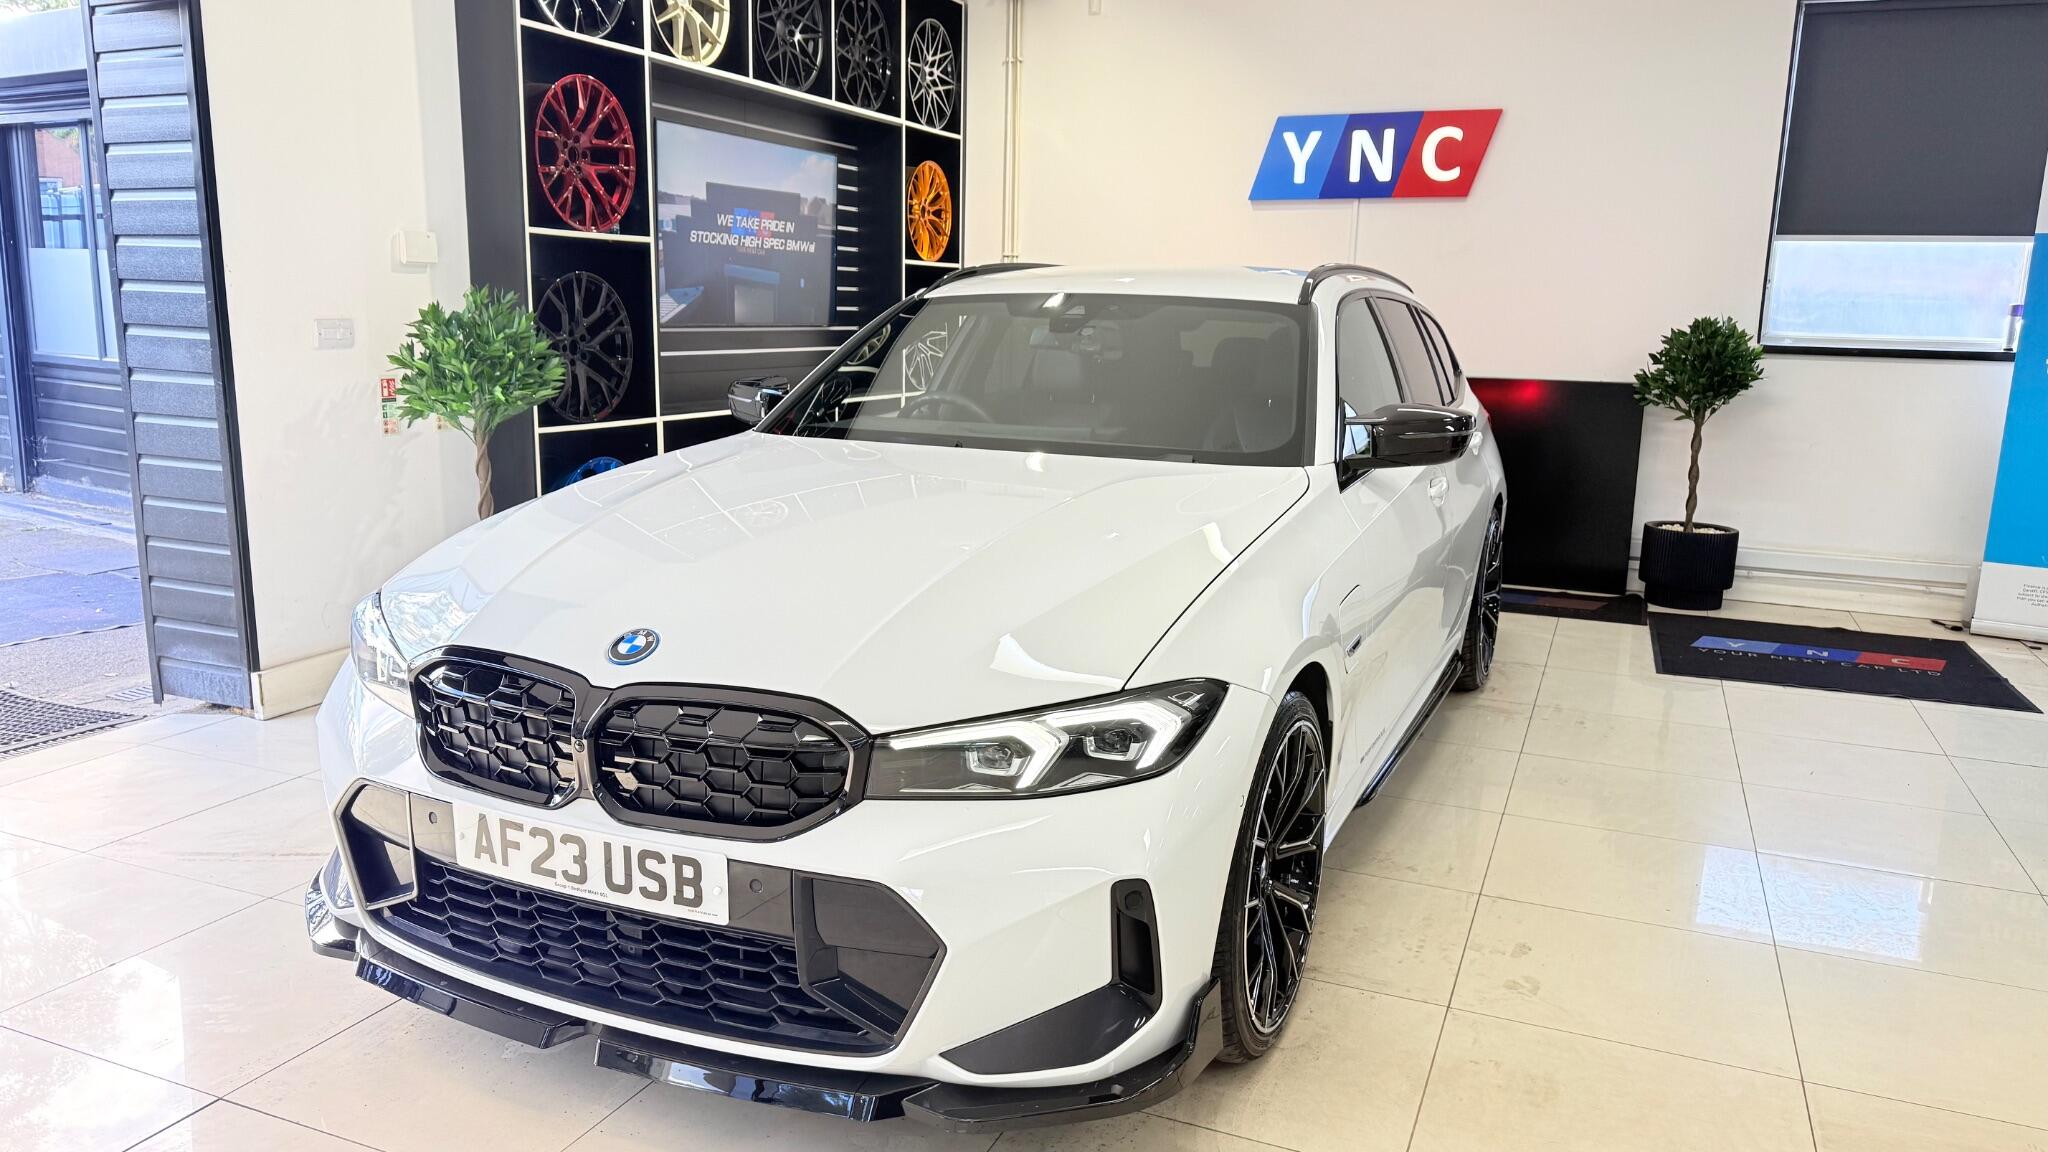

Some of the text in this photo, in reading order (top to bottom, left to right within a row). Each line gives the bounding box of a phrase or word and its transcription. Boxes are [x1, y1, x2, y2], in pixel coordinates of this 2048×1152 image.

[717, 213, 795, 233] WE TAKE PRIDE IN
[689, 230, 739, 247] STOCKING
[740, 235, 762, 249] HIGH
[763, 237, 785, 251] SPEC
[1698, 648, 1943, 677] YOUR NEXT CAR LTD
[474, 812, 704, 909] AF23 USB
